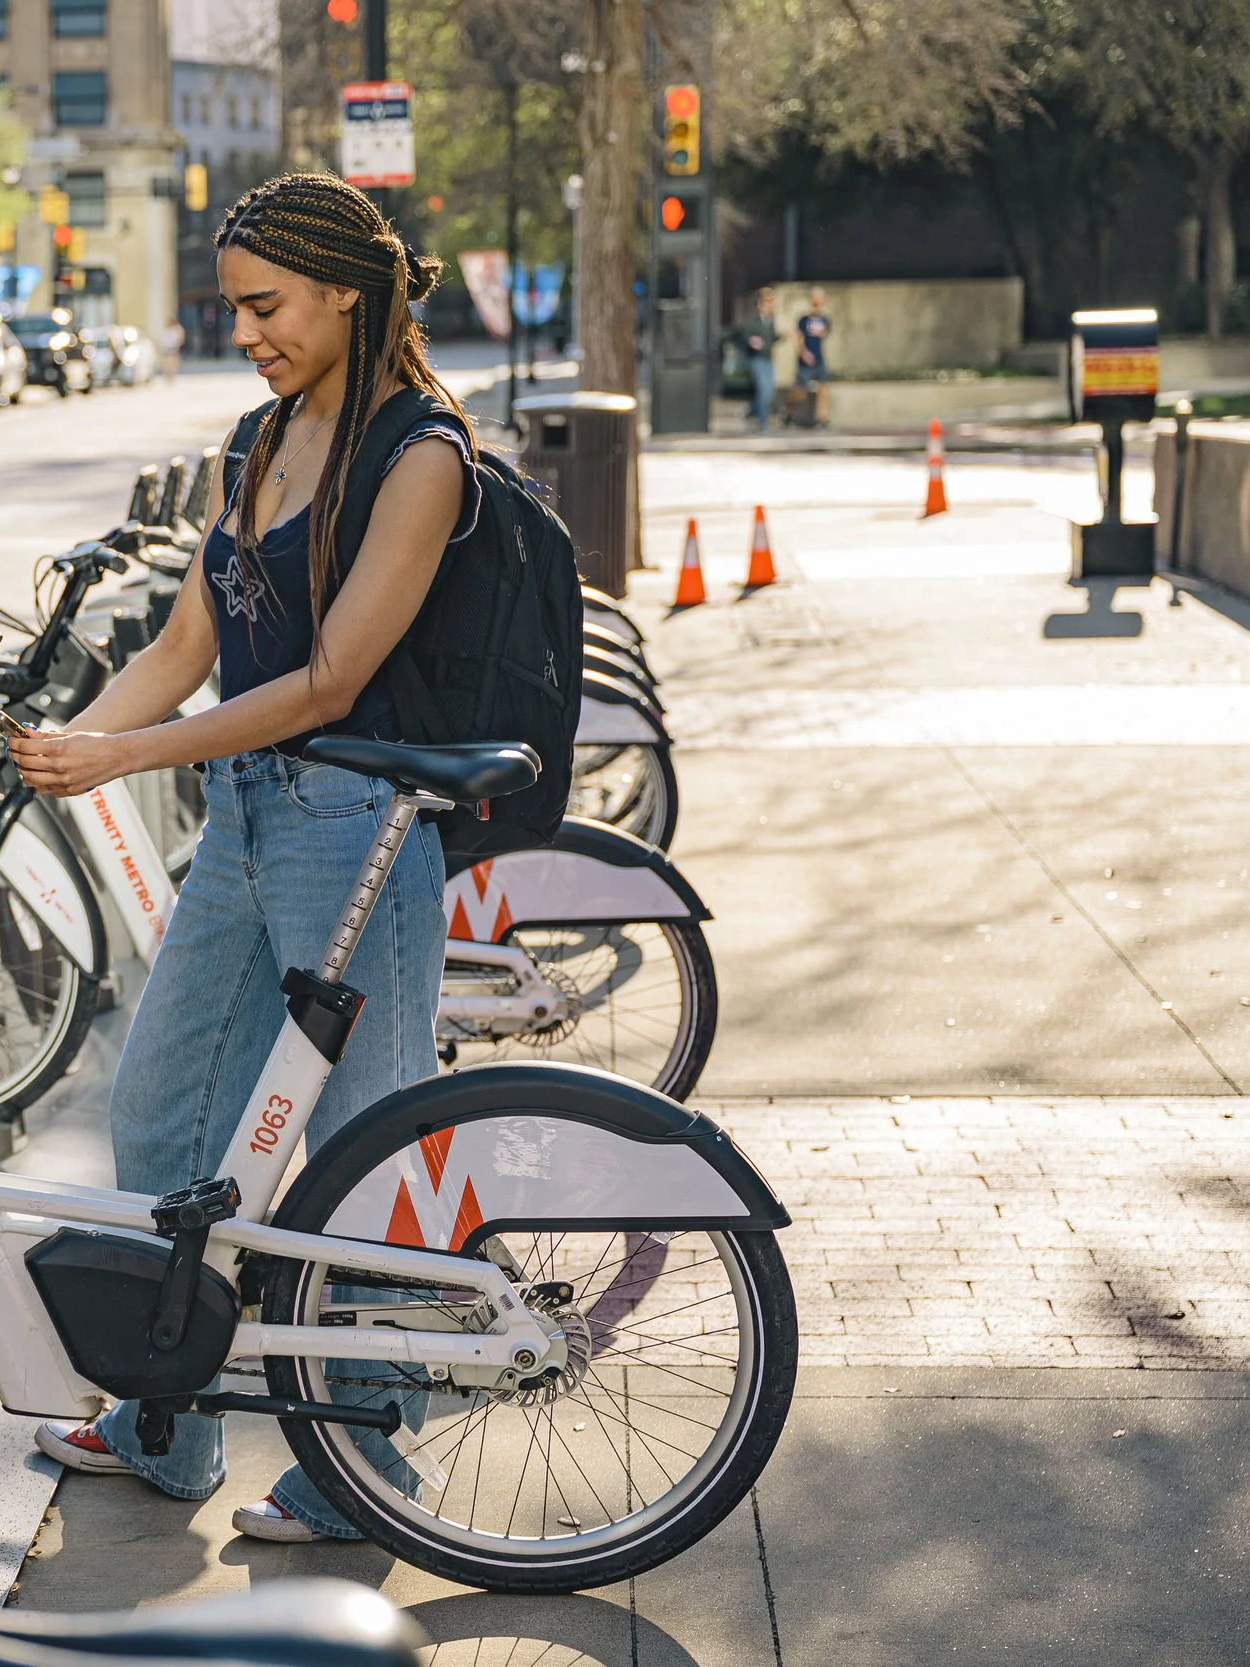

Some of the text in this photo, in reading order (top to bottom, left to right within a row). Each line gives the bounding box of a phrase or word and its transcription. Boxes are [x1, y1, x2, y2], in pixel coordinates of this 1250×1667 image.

[395, 817, 401, 826] 1
[384, 837, 392, 847] 2
[90, 788, 127, 852] TRINITY
[120, 855, 154, 913] METRO
[375, 857, 383, 866] 3
[366, 877, 374, 886] 4
[357, 897, 365, 906] 5
[349, 917, 356, 926] 6
[340, 936, 348, 945] 7
[331, 956, 338, 965] 8
[250, 1094, 293, 1155] 1063
